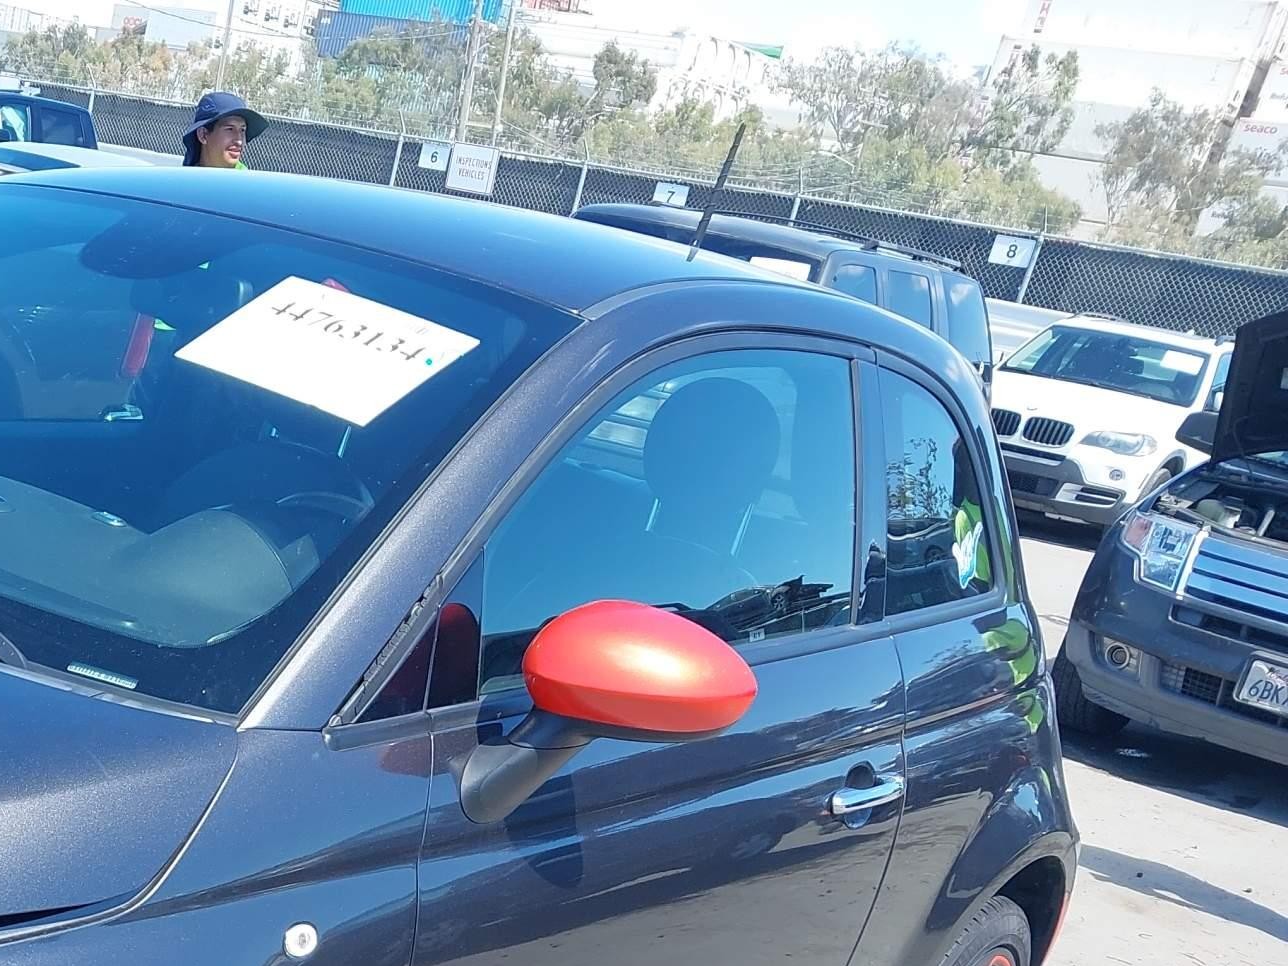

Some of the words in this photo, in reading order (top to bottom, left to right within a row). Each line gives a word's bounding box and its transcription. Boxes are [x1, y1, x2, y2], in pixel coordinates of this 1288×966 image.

[1243, 121, 1279, 135] seaco
[430, 150, 439, 163] 6
[458, 167, 485, 181] VEHICLES
[666, 189, 677, 203] 7
[1005, 243, 1019, 259] 8
[271, 302, 427, 361] 44763134
[1248, 679, 1288, 705] 6BK
